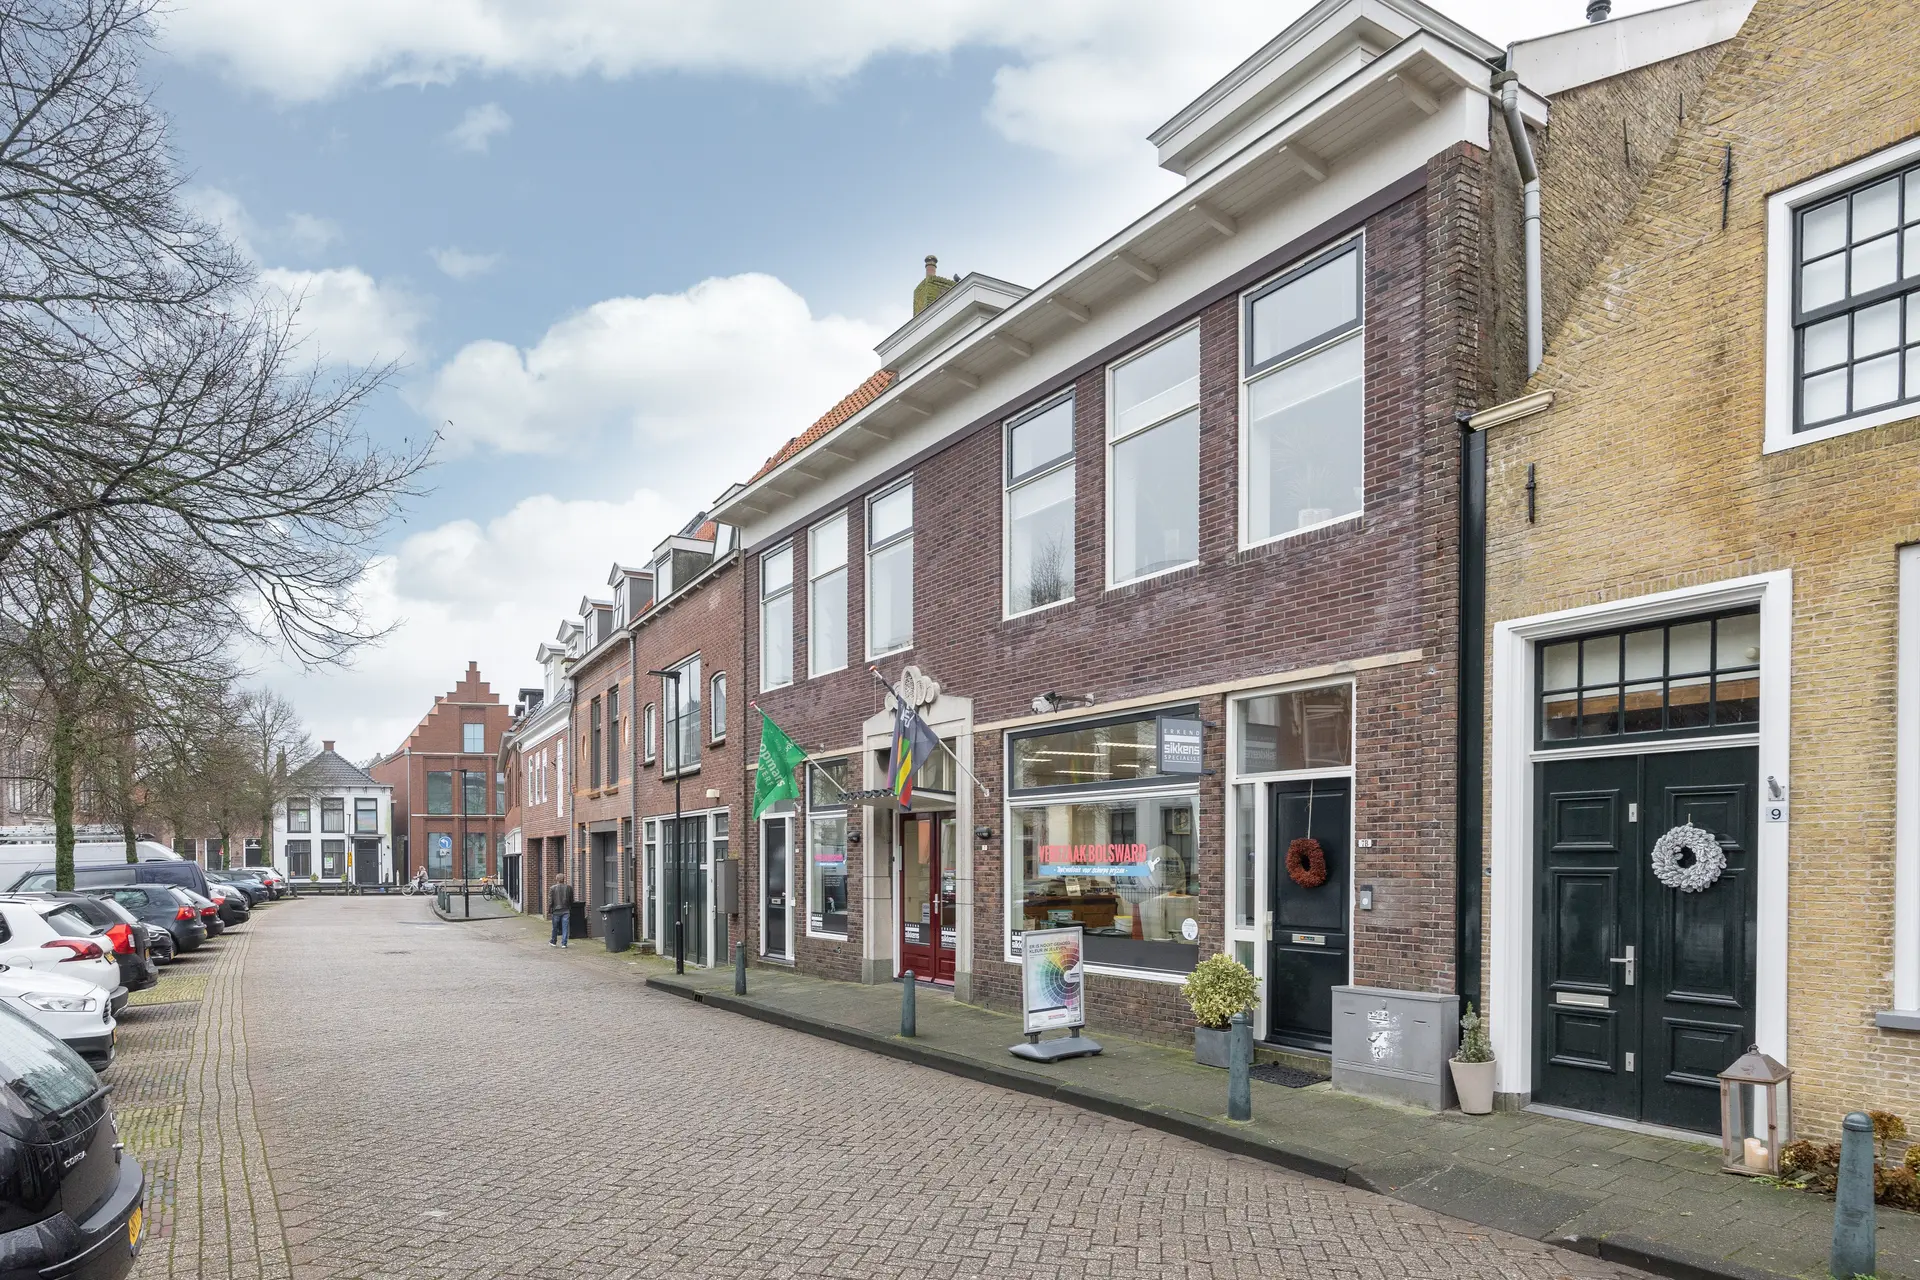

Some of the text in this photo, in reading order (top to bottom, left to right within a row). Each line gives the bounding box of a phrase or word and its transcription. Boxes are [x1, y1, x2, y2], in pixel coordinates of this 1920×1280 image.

[1164, 742, 1200, 755] sikkens
[1771, 808, 1781, 820] 9
[1088, 843, 1147, 863] BOLSWARD
[64, 1150, 88, 1169] CORSA
